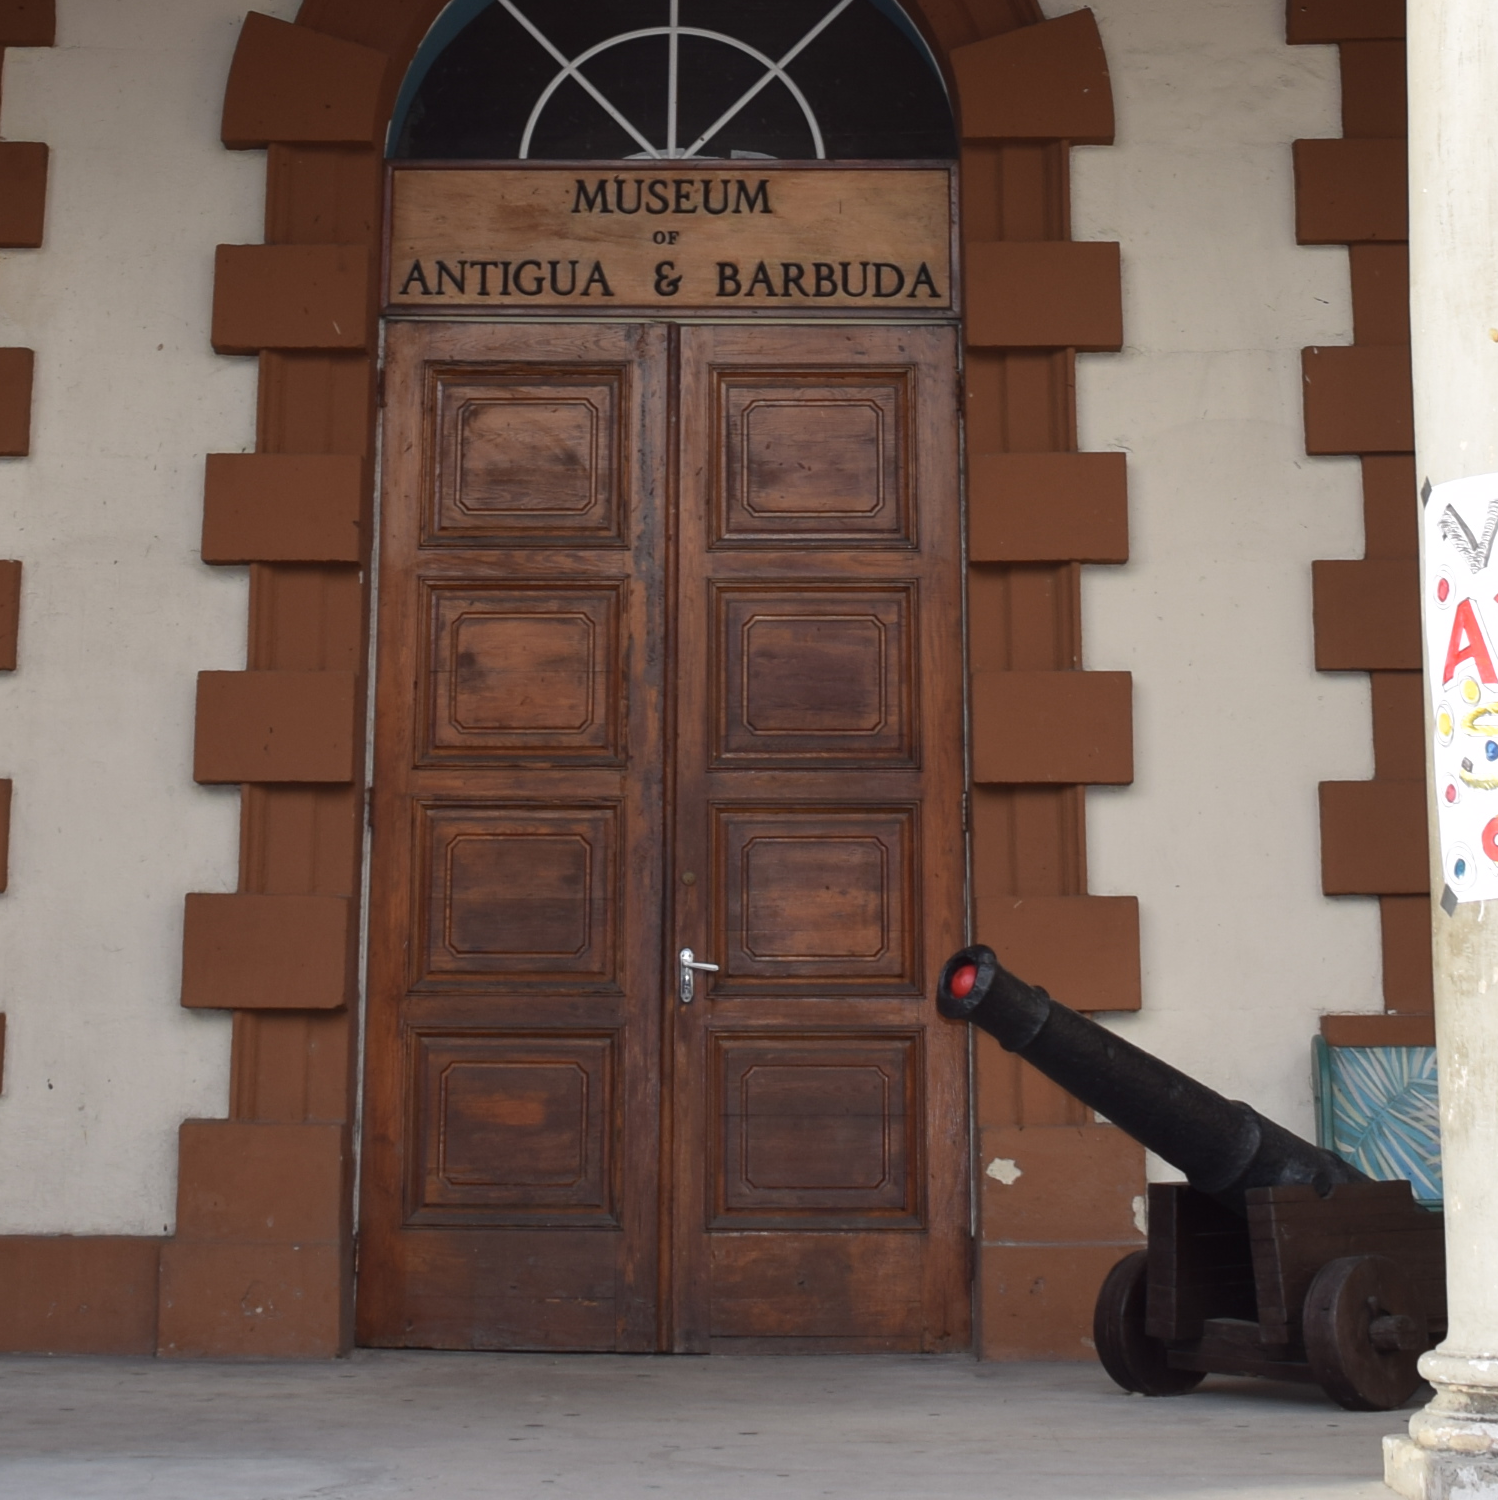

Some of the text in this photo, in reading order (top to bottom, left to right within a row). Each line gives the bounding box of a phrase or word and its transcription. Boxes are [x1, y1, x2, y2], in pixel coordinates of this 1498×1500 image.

[570, 179, 774, 215] MUSEUM
[652, 230, 680, 246] OF
[399, 258, 942, 299] ANTIGUA & BARBUDA
